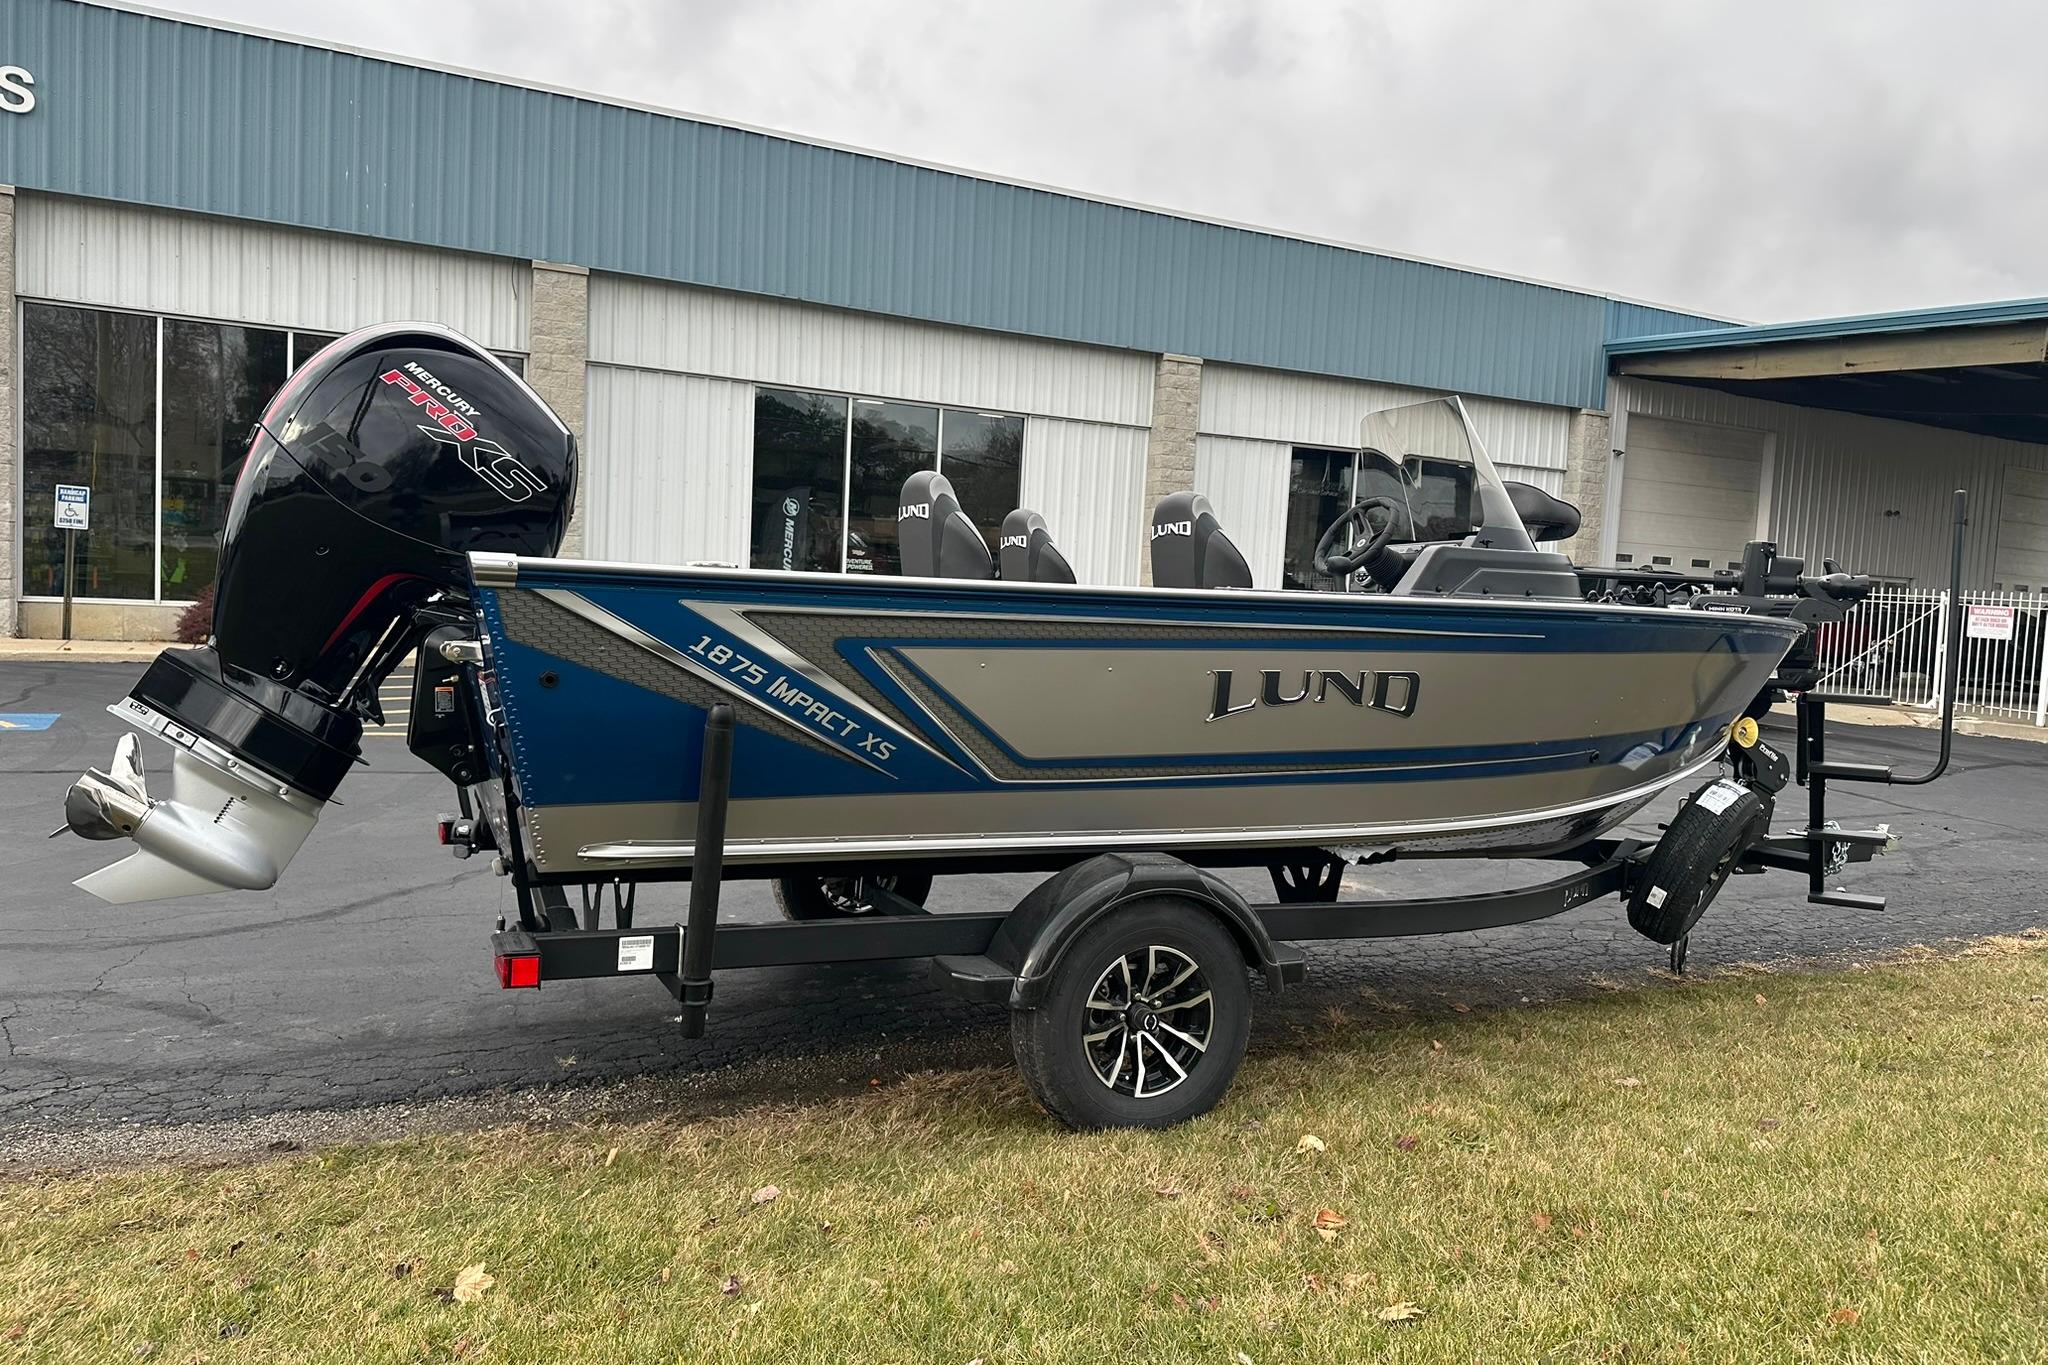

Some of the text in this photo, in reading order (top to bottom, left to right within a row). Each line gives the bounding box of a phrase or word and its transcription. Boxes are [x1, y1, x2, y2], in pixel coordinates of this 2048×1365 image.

[0, 65, 36, 114] S
[379, 368, 478, 442] PRO
[403, 361, 481, 417] MERCURY
[296, 420, 393, 493] 150
[416, 424, 549, 502] XS
[61, 494, 85, 502] PARKING
[898, 503, 931, 522] LUND
[1000, 535, 1027, 550] LUND
[1151, 521, 1191, 541] LUND
[1974, 608, 2009, 616] WARNING
[688, 635, 897, 760] 1875 IMPACT XS
[1205, 669, 1420, 722] LUND
